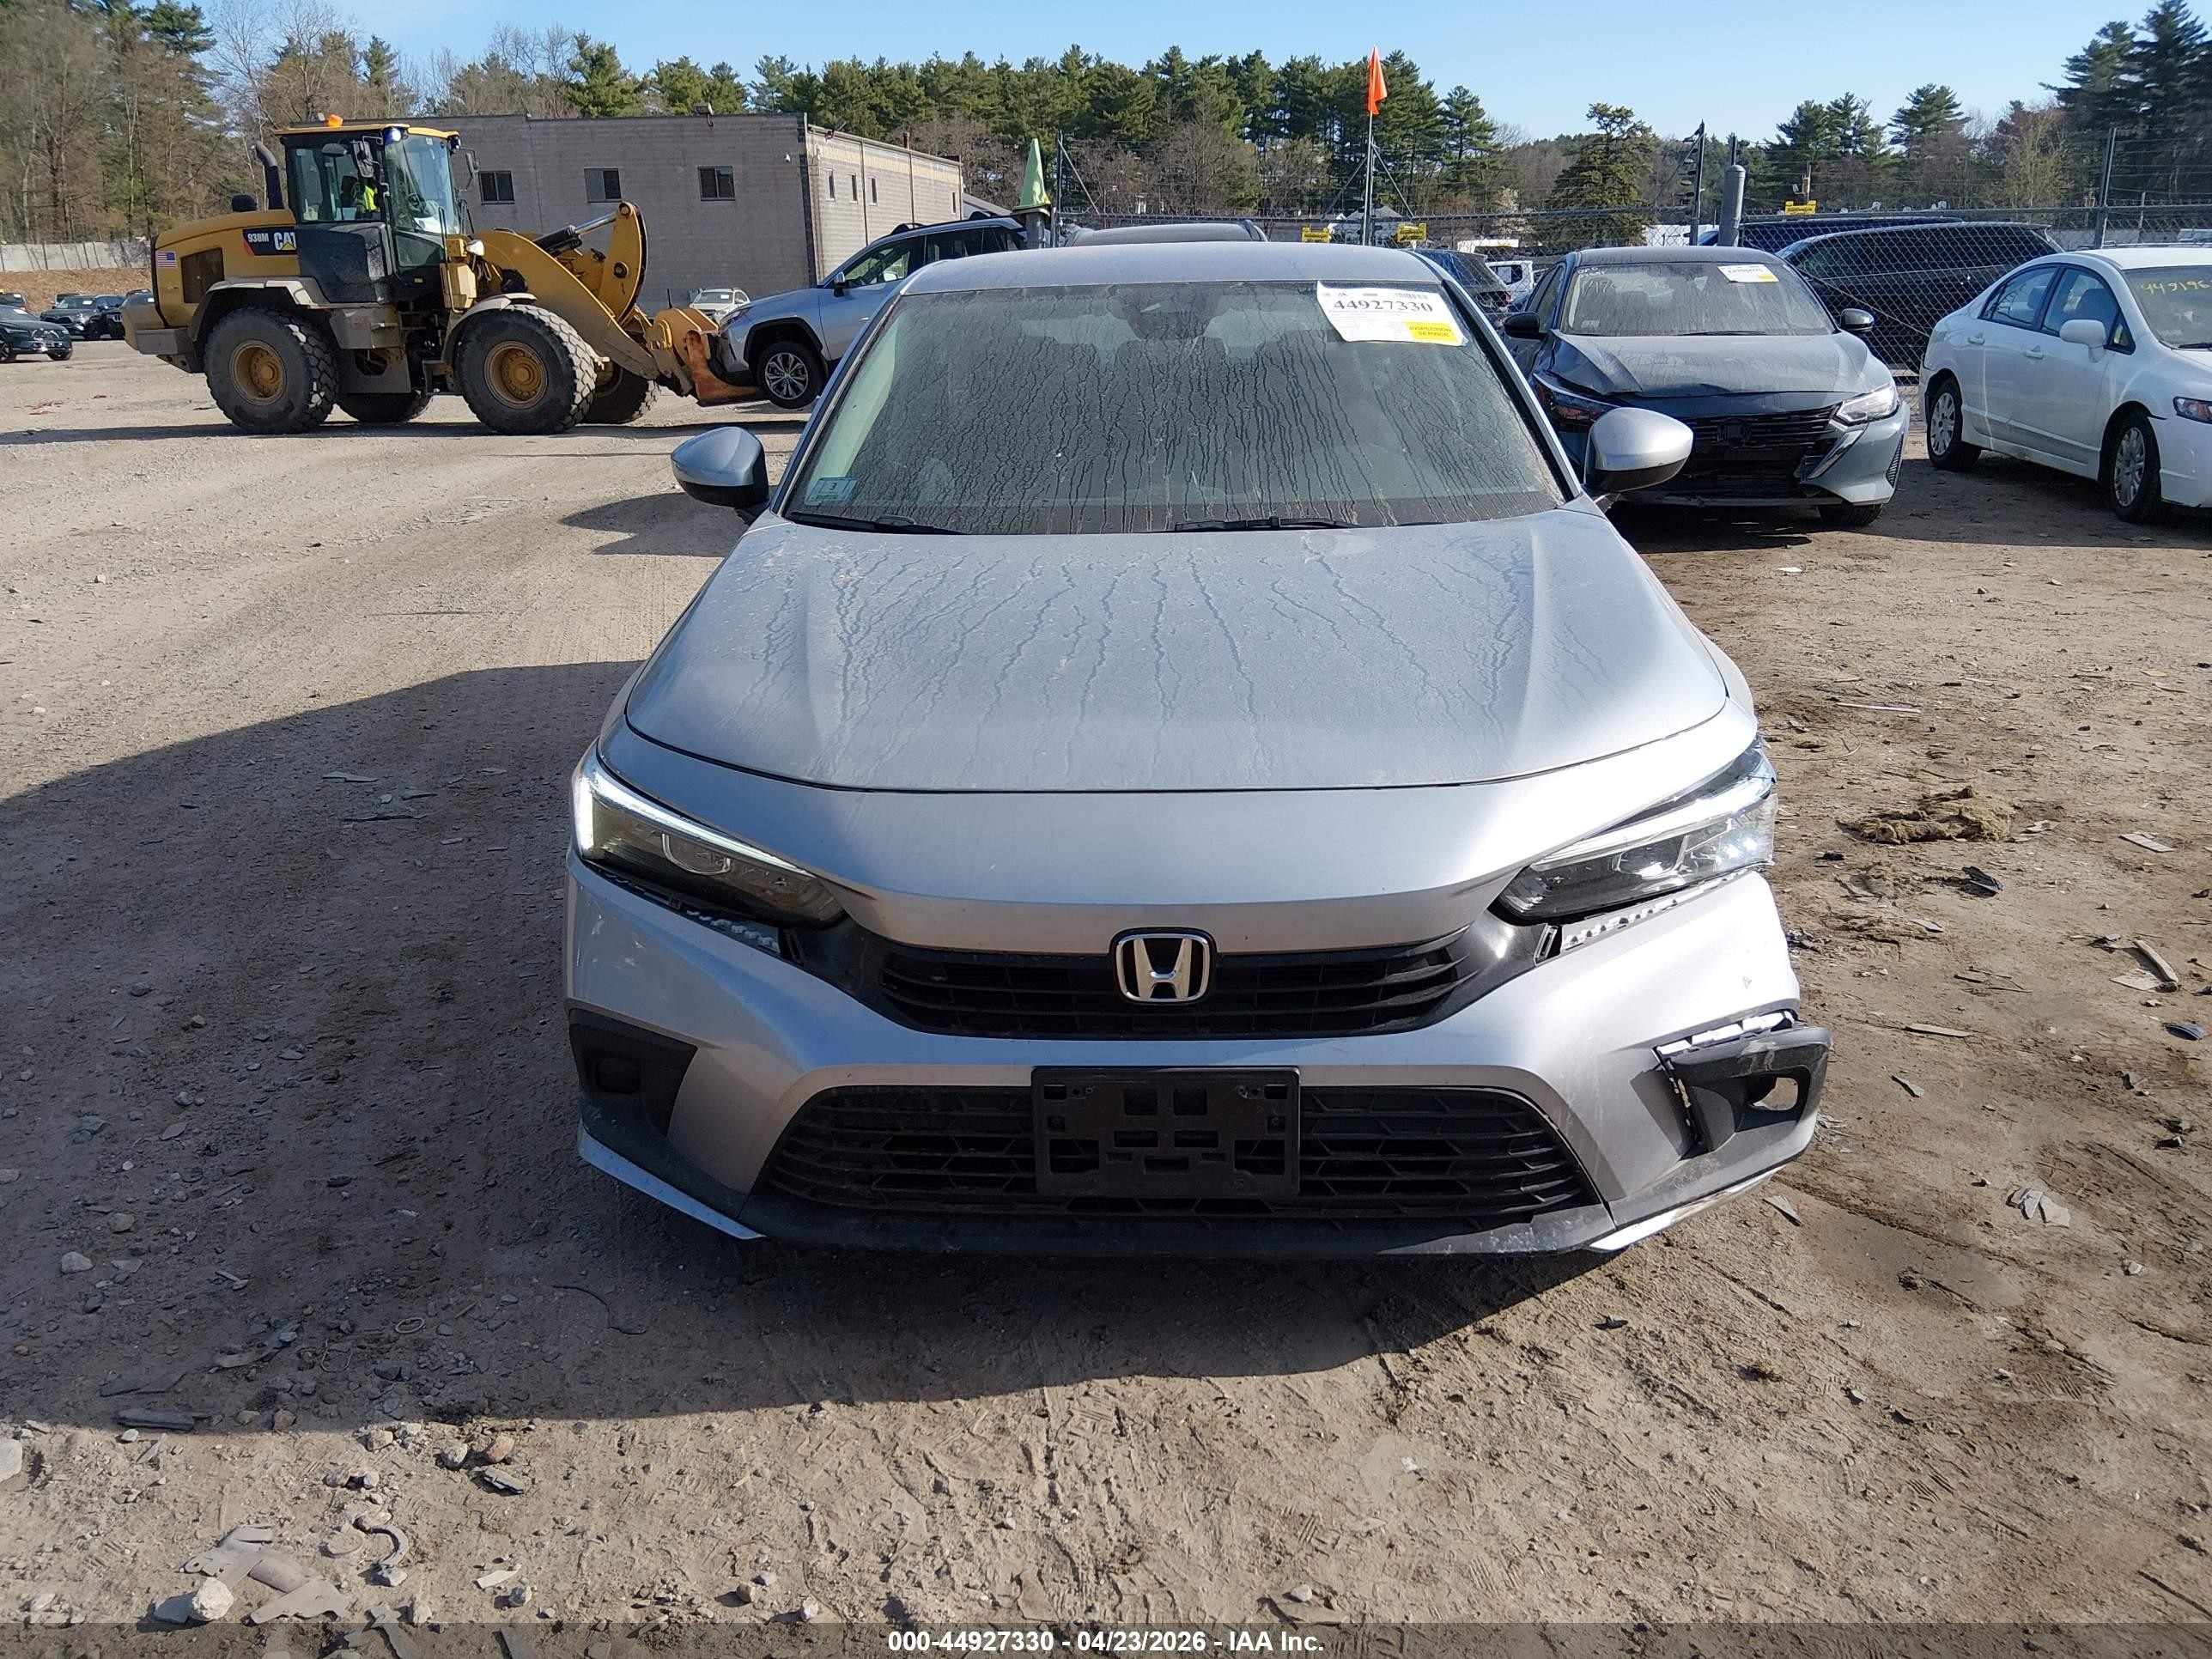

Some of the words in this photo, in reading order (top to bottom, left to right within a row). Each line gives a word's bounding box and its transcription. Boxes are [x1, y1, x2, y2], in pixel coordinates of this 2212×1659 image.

[247, 233, 270, 243] 938M
[274, 232, 297, 251] CAT
[1334, 300, 1433, 313] 44927330
